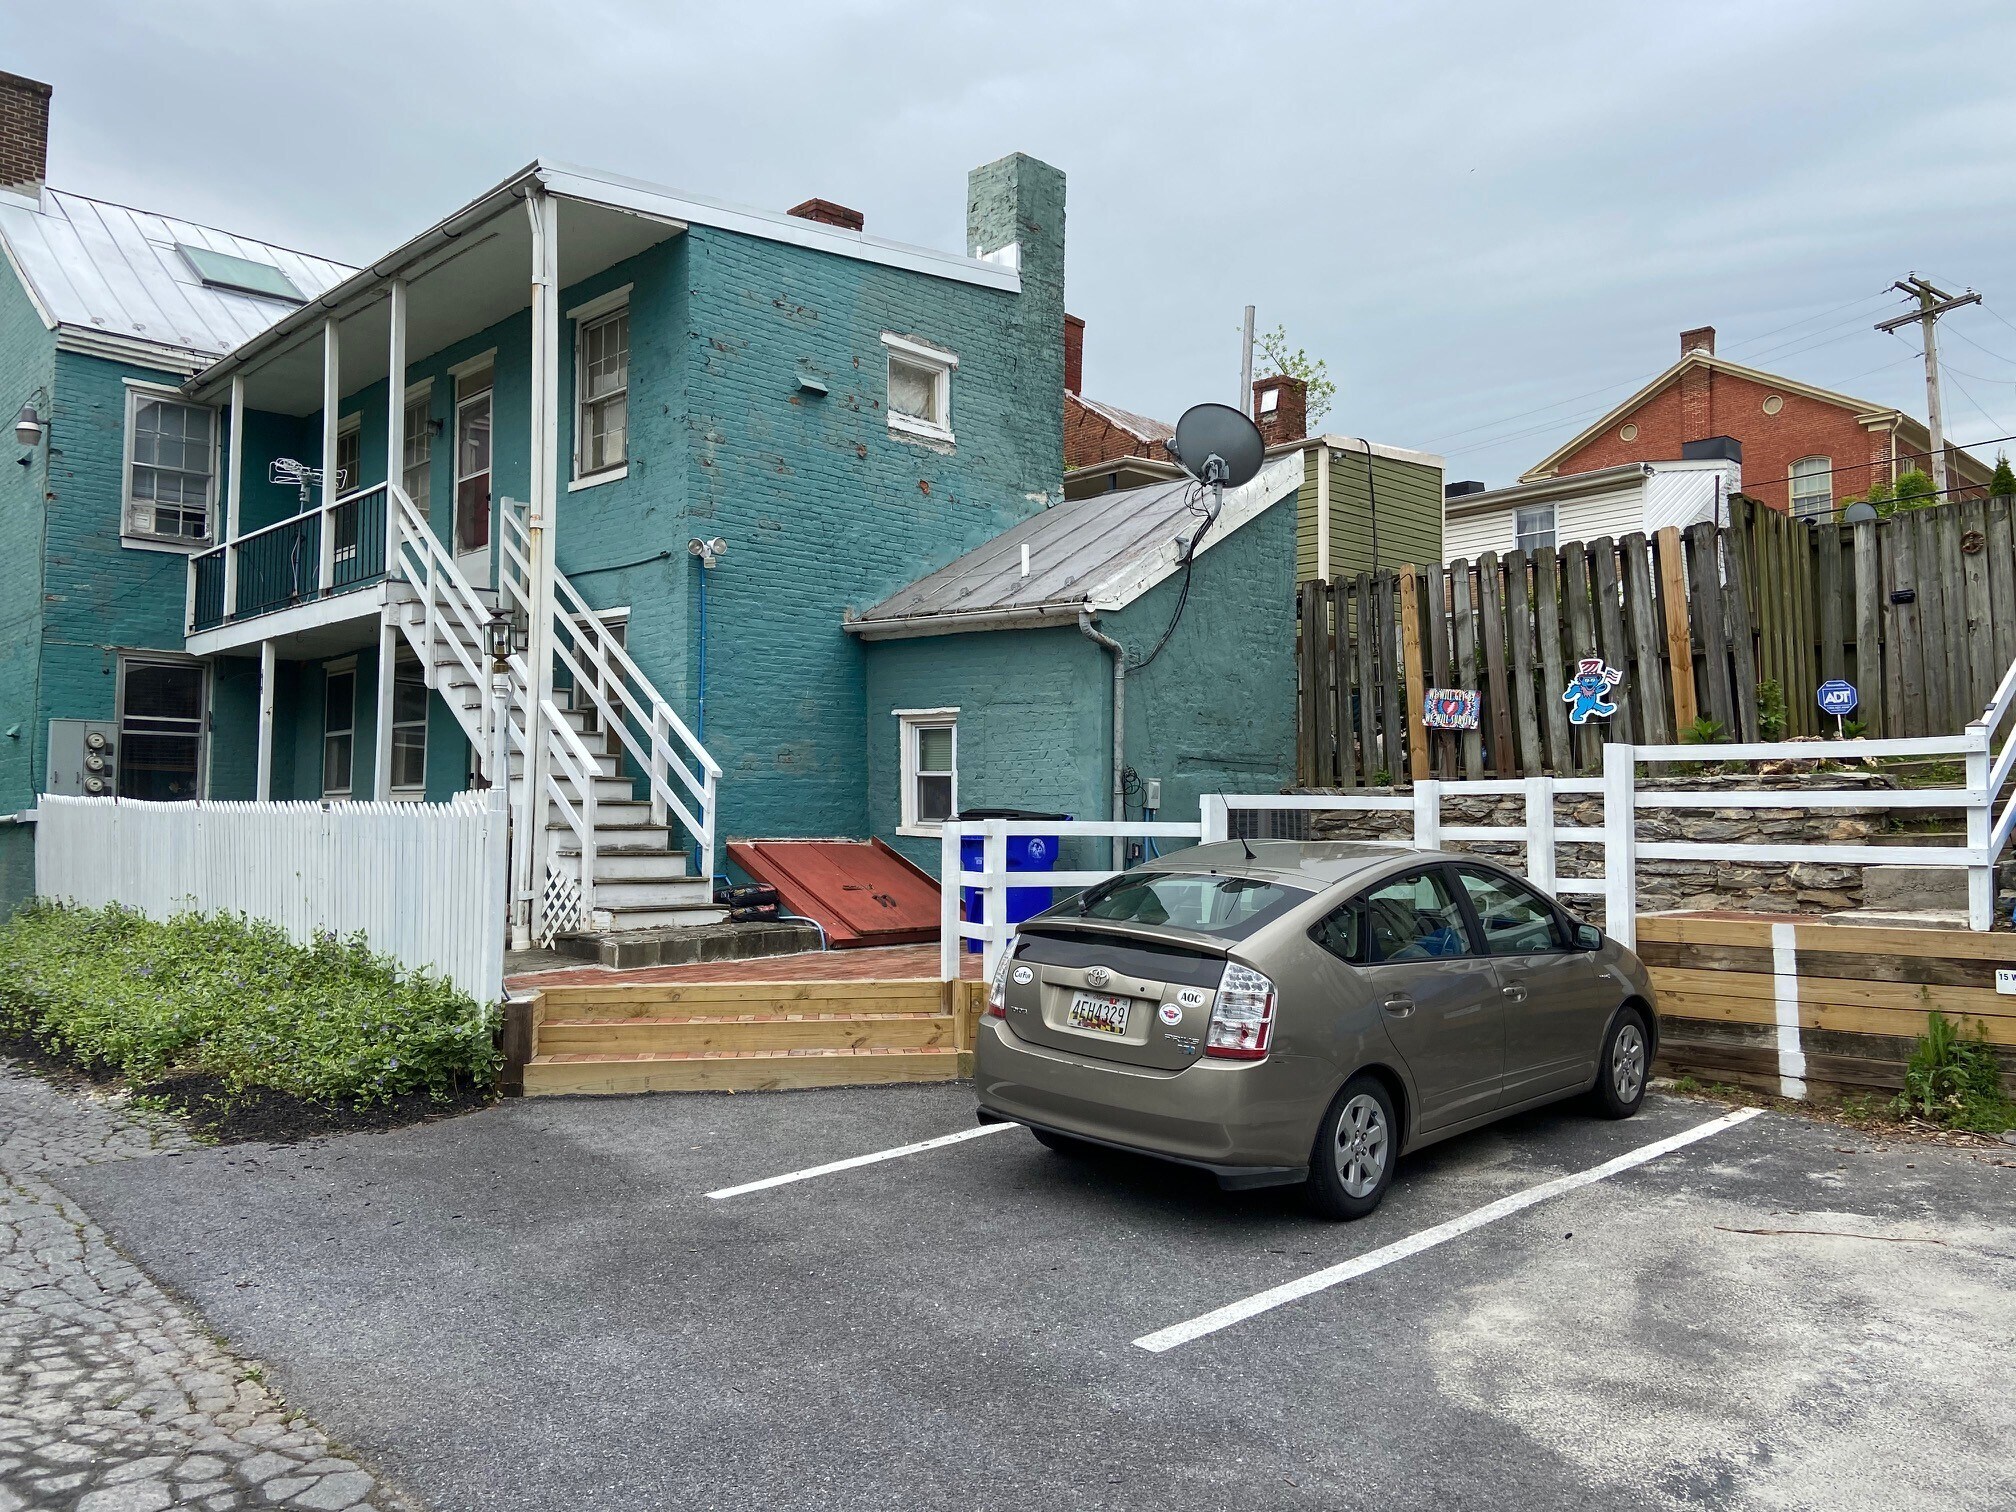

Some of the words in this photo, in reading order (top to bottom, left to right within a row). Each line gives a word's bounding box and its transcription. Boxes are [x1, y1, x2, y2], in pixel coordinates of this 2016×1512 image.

[1429, 688, 1439, 699] WE
[1825, 690, 1850, 703] ADT
[1425, 713, 1435, 723] WE
[1435, 713, 1449, 724] WILL
[1999, 973, 2009, 981] 15
[1181, 992, 1201, 1004] AOC
[1072, 999, 1125, 1025] 4EH4329
